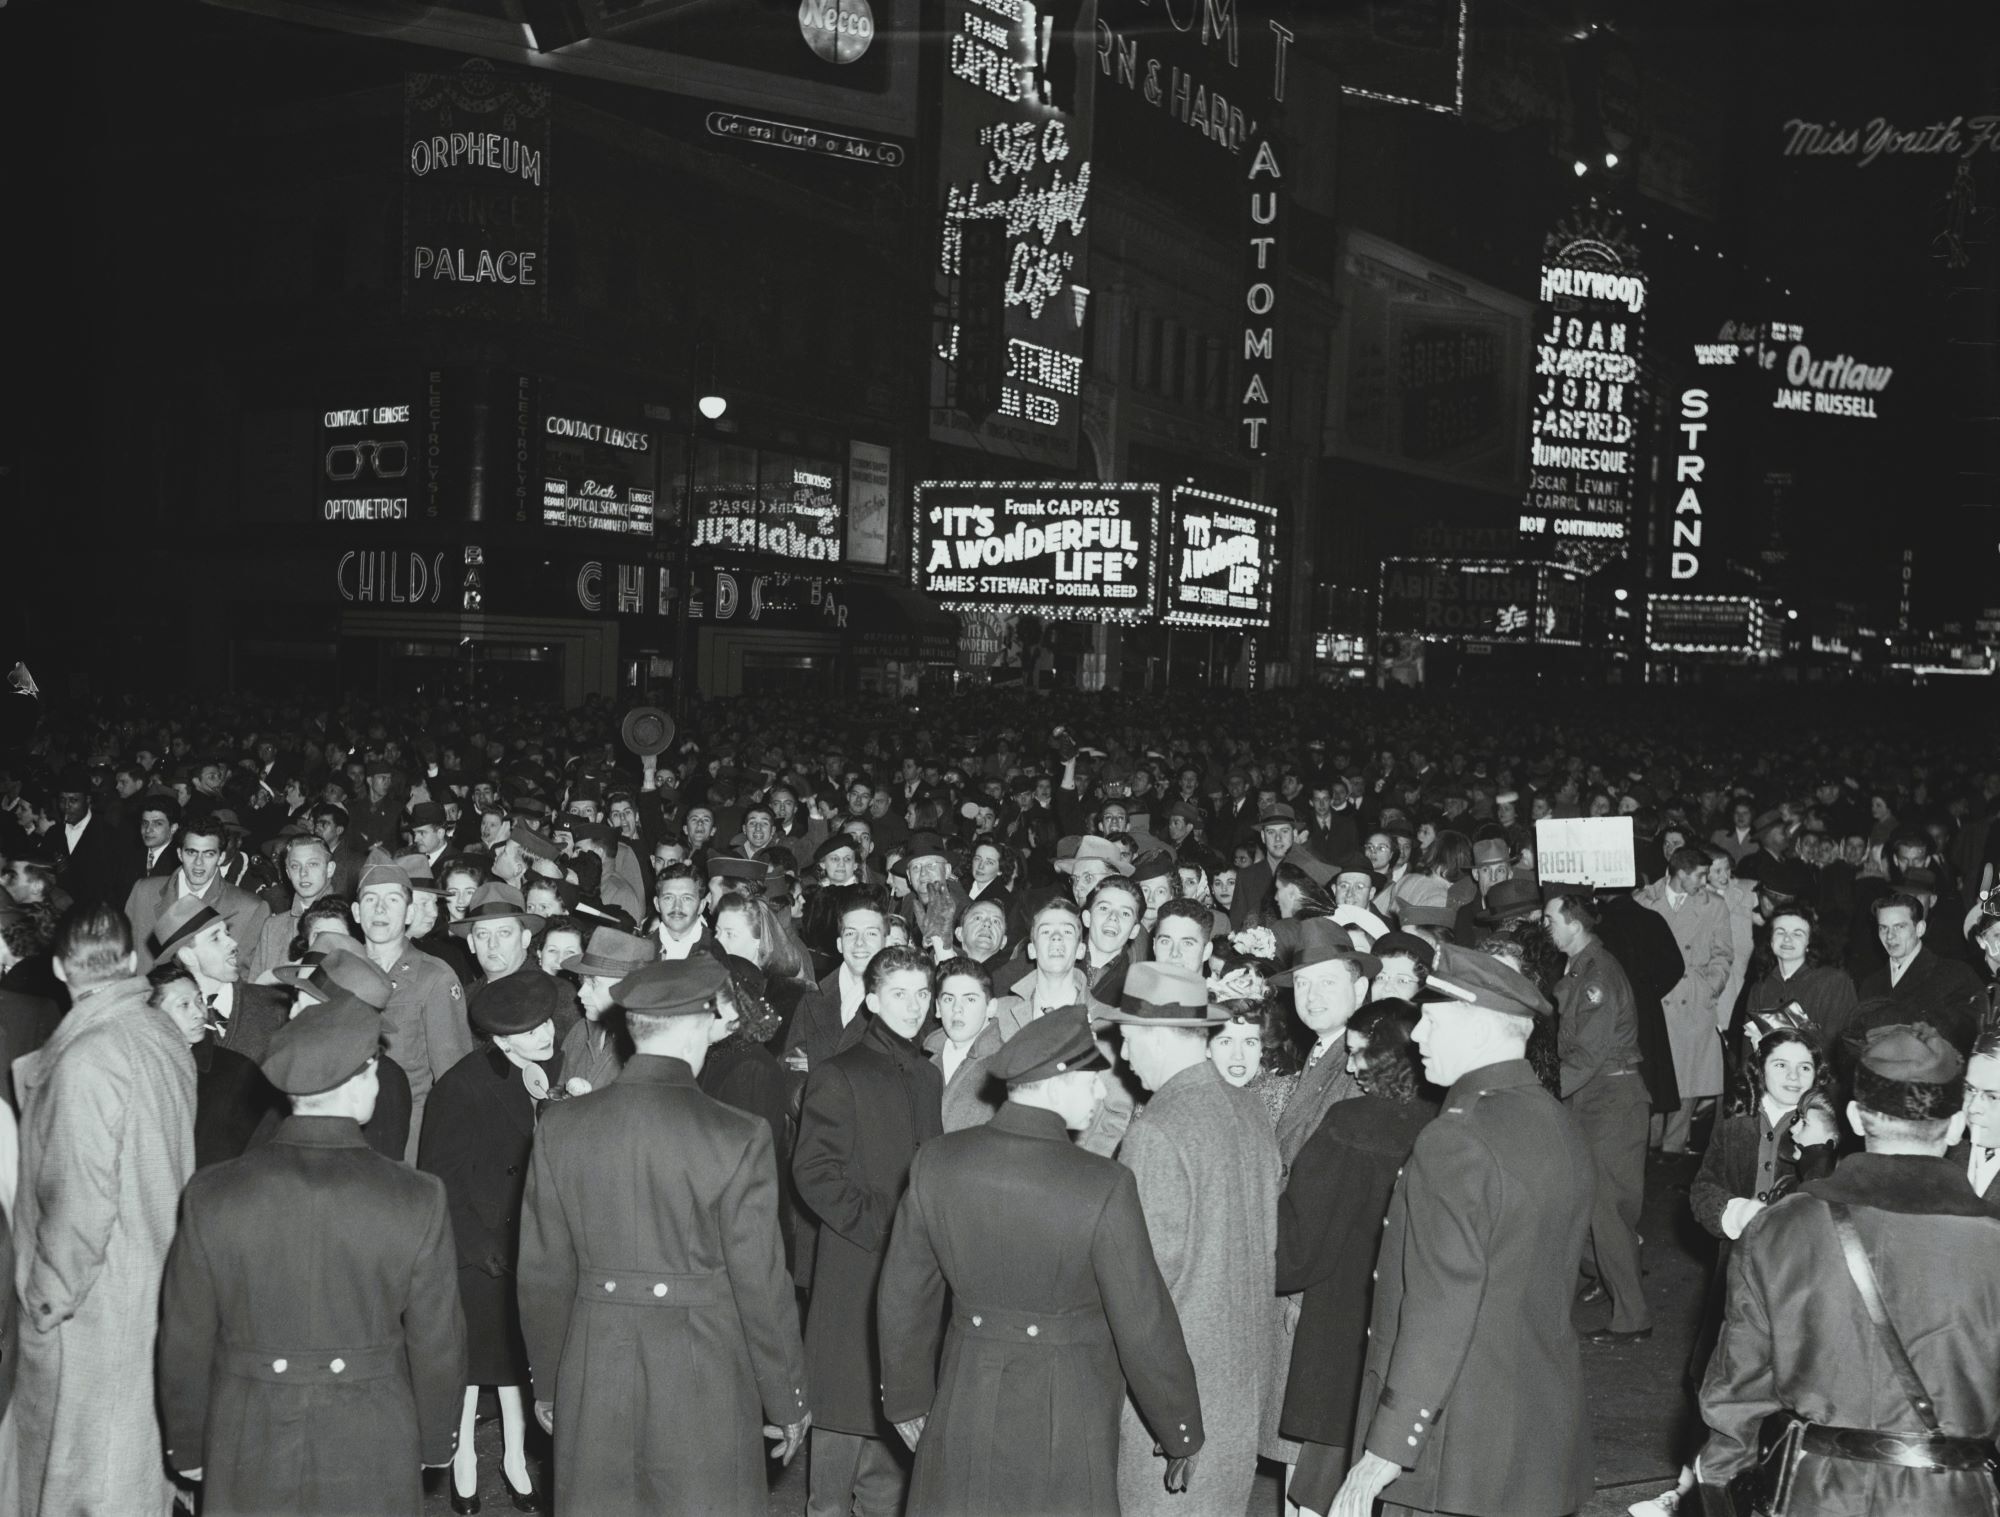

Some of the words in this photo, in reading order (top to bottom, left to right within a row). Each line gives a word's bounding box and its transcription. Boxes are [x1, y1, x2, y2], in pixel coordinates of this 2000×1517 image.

[802, 0, 871, 38] Necco
[411, 131, 541, 187] ORPHEUM
[844, 141, 872, 159] Adv
[875, 145, 897, 163] Co
[1783, 117, 1860, 157] Miss
[1856, 115, 1964, 169] Youth
[414, 246, 537, 286] PALACE
[1242, 139, 1282, 450] AUTOMAT
[1540, 265, 1645, 313] HOLLYWOOD
[1543, 315, 1627, 353] JOAN
[1787, 344, 1893, 392] Outlaw
[1538, 377, 1624, 413] JOHN
[1773, 387, 1812, 412] JANE
[1814, 391, 1878, 419] RUSSELL
[325, 408, 369, 428] CONTACT
[373, 404, 410, 425] LENSES
[546, 416, 602, 442] CONTACT
[604, 426, 649, 451] LENSES
[515, 376, 529, 522] ELECTROLYSIS
[580, 480, 617, 500] Rich
[1575, 471, 1620, 496] LEVANT
[1671, 388, 1710, 580] STRAND
[325, 497, 408, 520] OPTOMETRIST
[567, 497, 598, 514] OPTICAL
[598, 500, 629, 517] SERVICE
[568, 514, 588, 528] EYES
[930, 504, 995, 537] "IT'S
[1004, 498, 1046, 516] Frank
[1046, 497, 1120, 517] CAPRA'S
[1535, 493, 1582, 512] CARROL
[1587, 497, 1624, 514] NAISH
[1519, 515, 1547, 534] NOW
[1553, 518, 1625, 539] CONTINUOUS
[926, 540, 953, 574] A
[955, 518, 1139, 570] WONDERFUL
[337, 550, 445, 604] CHILDS
[463, 545, 484, 611] BAR
[1054, 550, 1139, 581] LIFE"
[576, 560, 762, 622] CHILDS
[810, 578, 849, 630] BAR
[926, 575, 976, 593] JAMES
[979, 576, 1050, 595] STEWART
[1055, 583, 1100, 597] DONNA
[1103, 584, 1138, 598] REED
[1539, 850, 1587, 875] RIGHT
